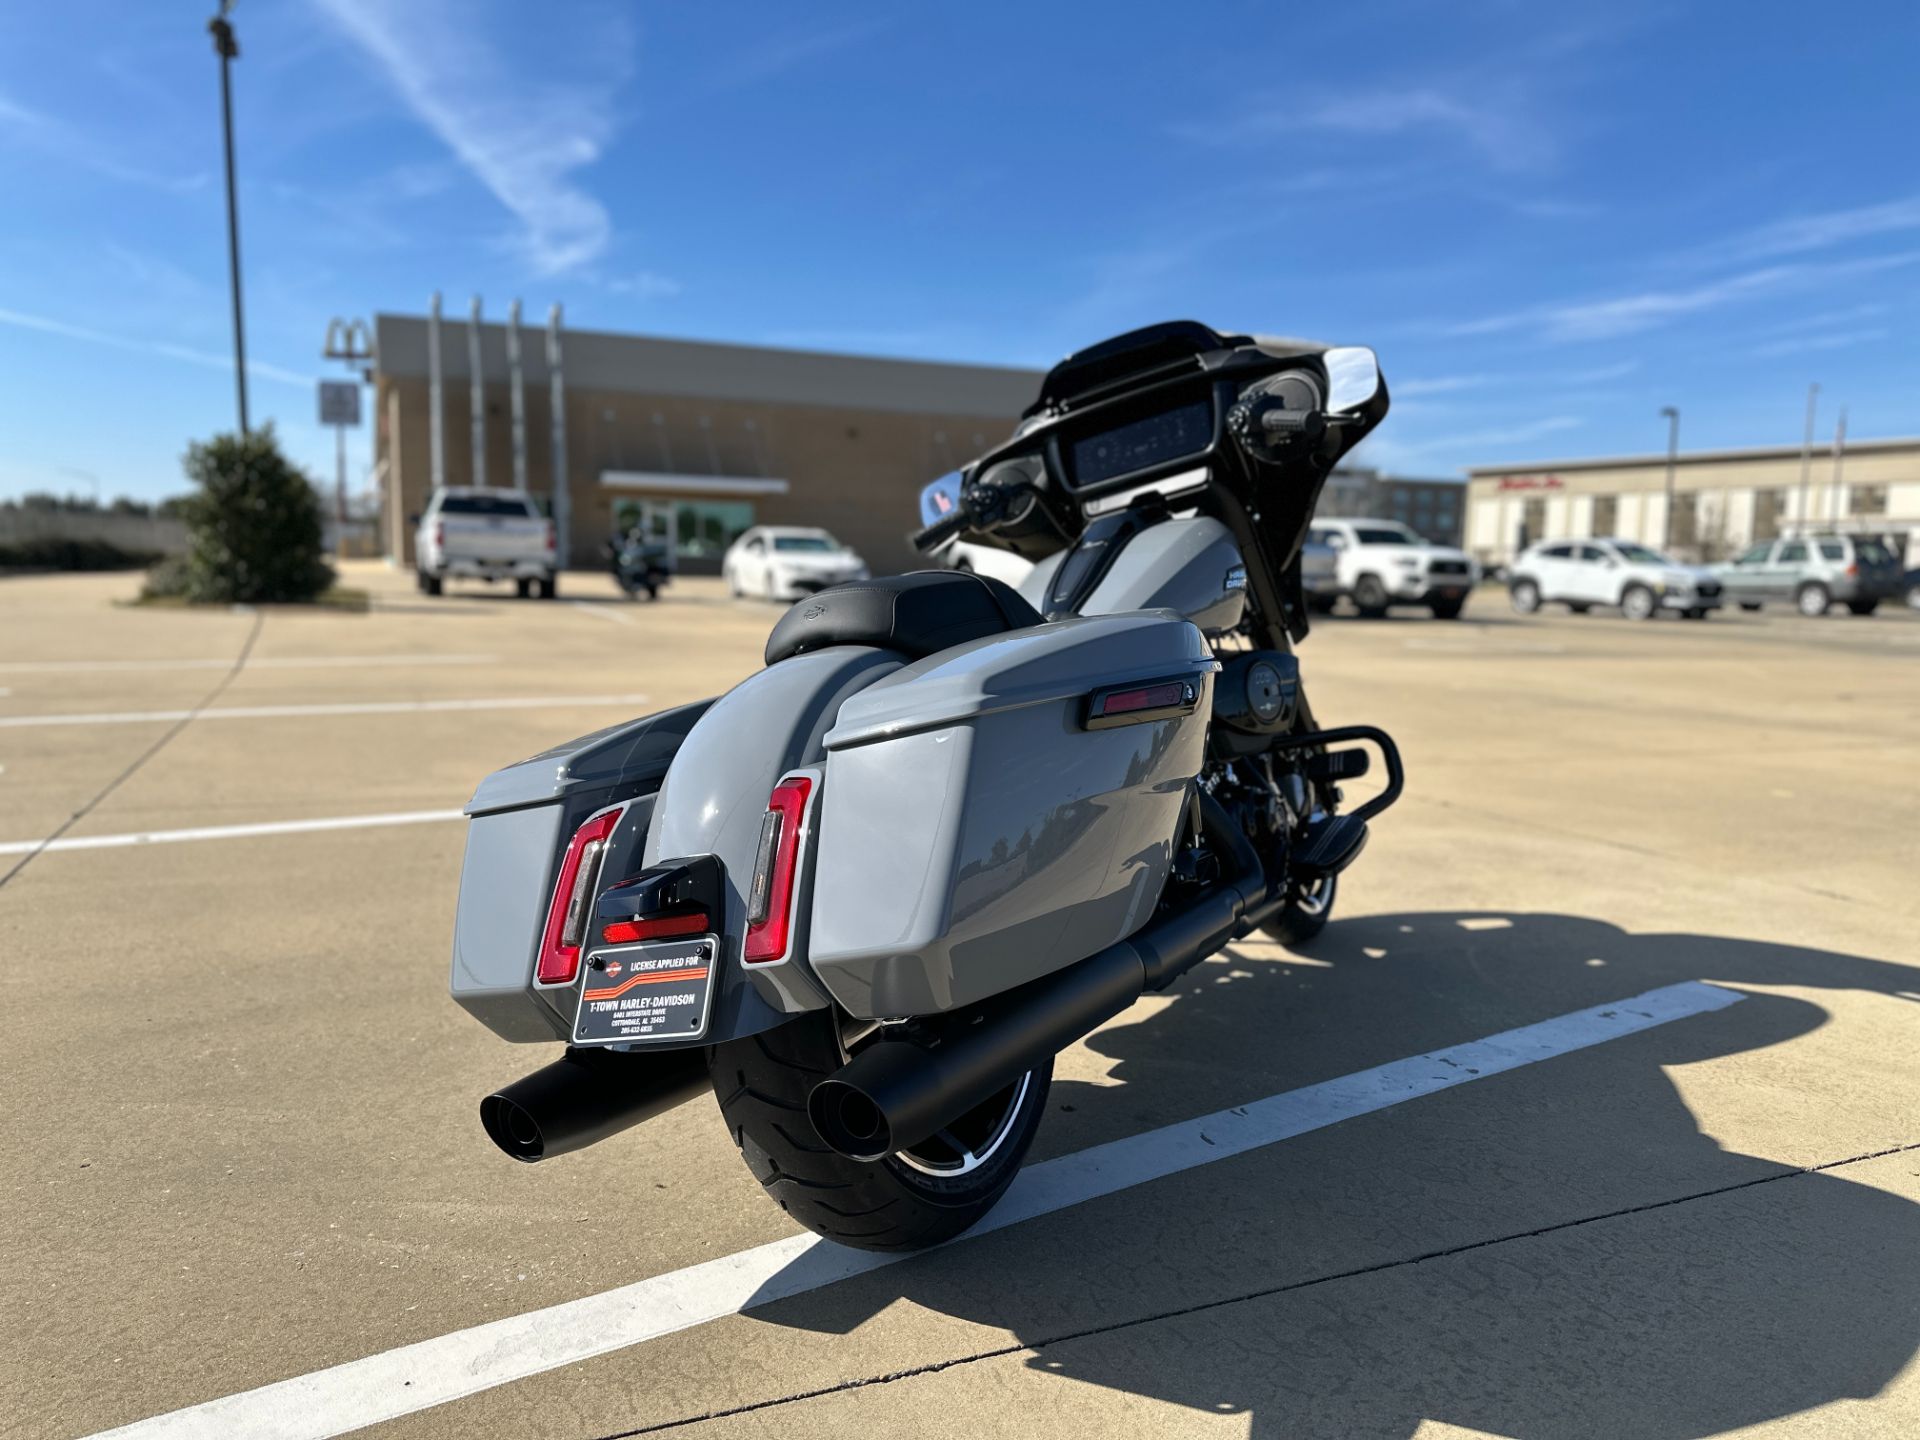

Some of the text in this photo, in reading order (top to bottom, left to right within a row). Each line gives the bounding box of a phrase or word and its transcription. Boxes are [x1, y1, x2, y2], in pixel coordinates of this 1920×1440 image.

[631, 962, 656, 972] LICENSE
[656, 958, 683, 968] APPLIED
[685, 956, 698, 966] FOR
[590, 994, 695, 1012] T-TOWN HARLEY-DAVIDSON
[626, 1010, 651, 1018] INTERSTATE
